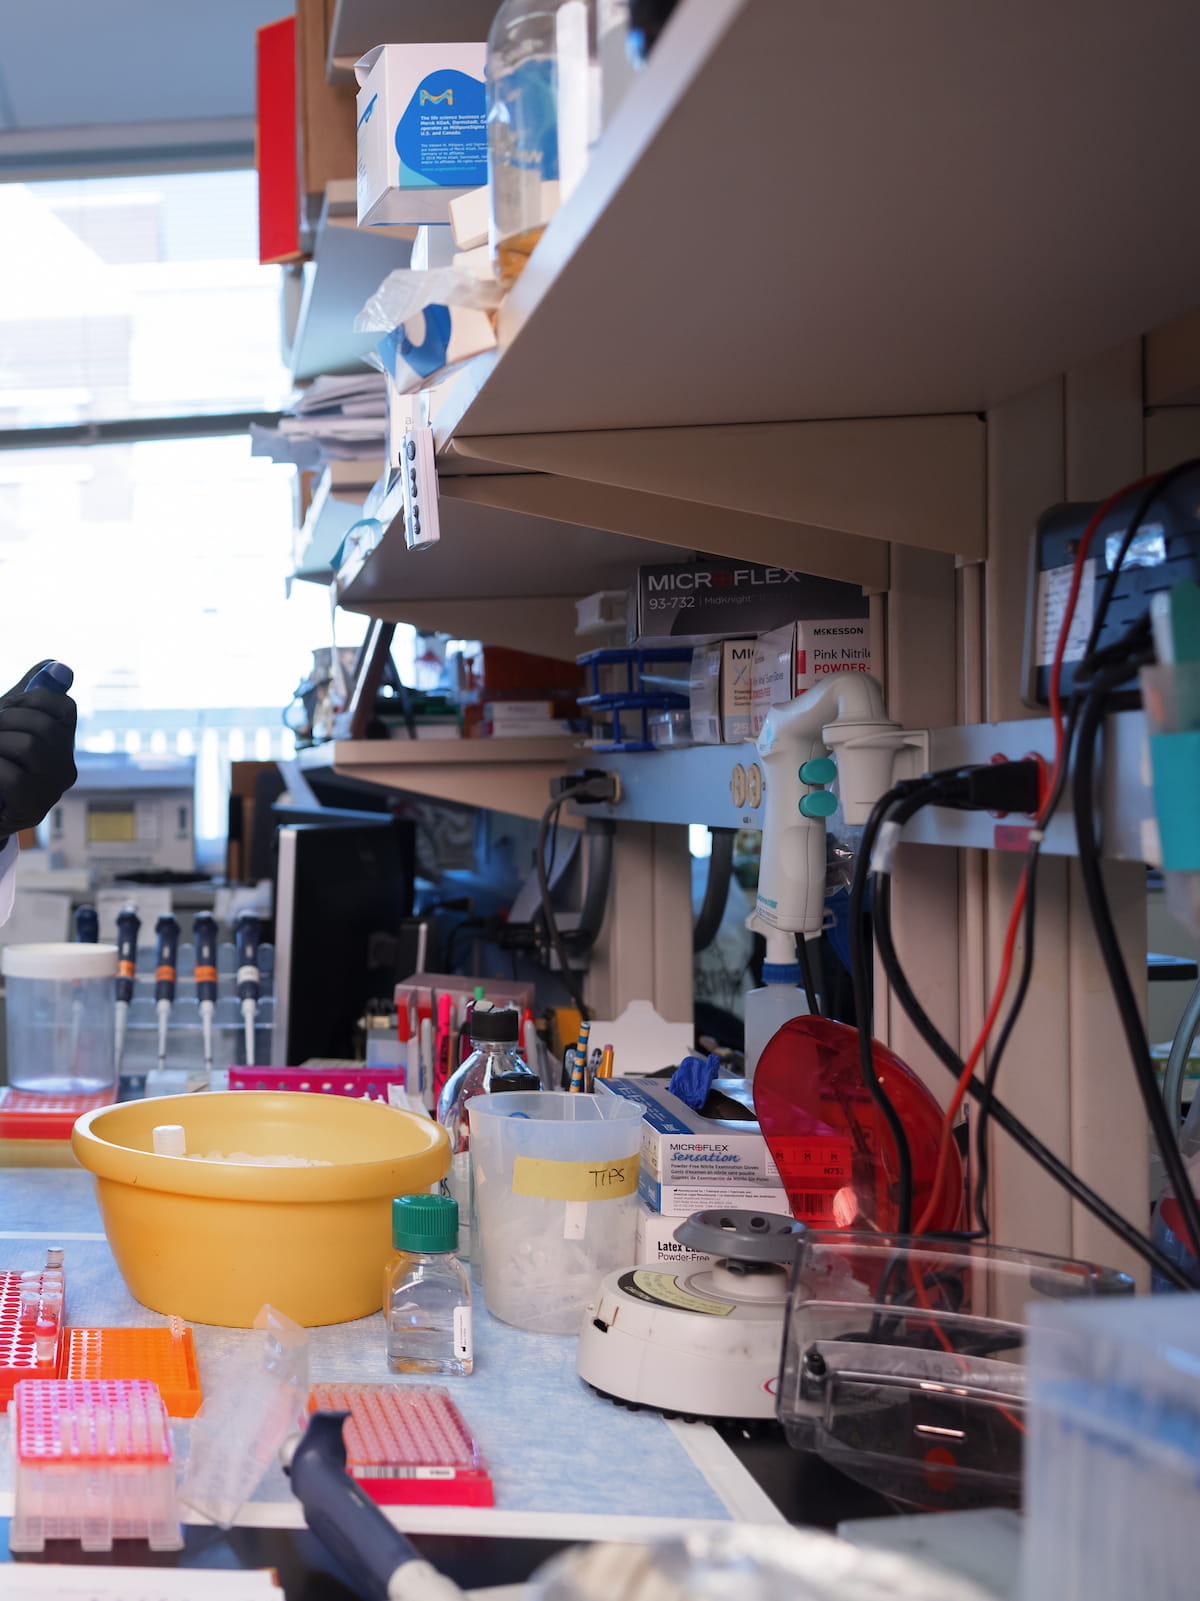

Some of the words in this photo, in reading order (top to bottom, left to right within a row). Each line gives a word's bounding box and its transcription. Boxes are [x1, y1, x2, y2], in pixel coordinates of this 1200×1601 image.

[648, 567, 800, 591] MICROFLEX
[649, 596, 695, 610] 93-732
[731, 649, 753, 660] MI
[814, 649, 837, 659] Pink
[670, 1143, 728, 1151] MICROFLEX
[670, 1152, 741, 1163] Sensation
[588, 1168, 625, 1188] TIPS
[657, 1241, 682, 1252] Latex
[657, 1252, 710, 1261] Powder-Free
